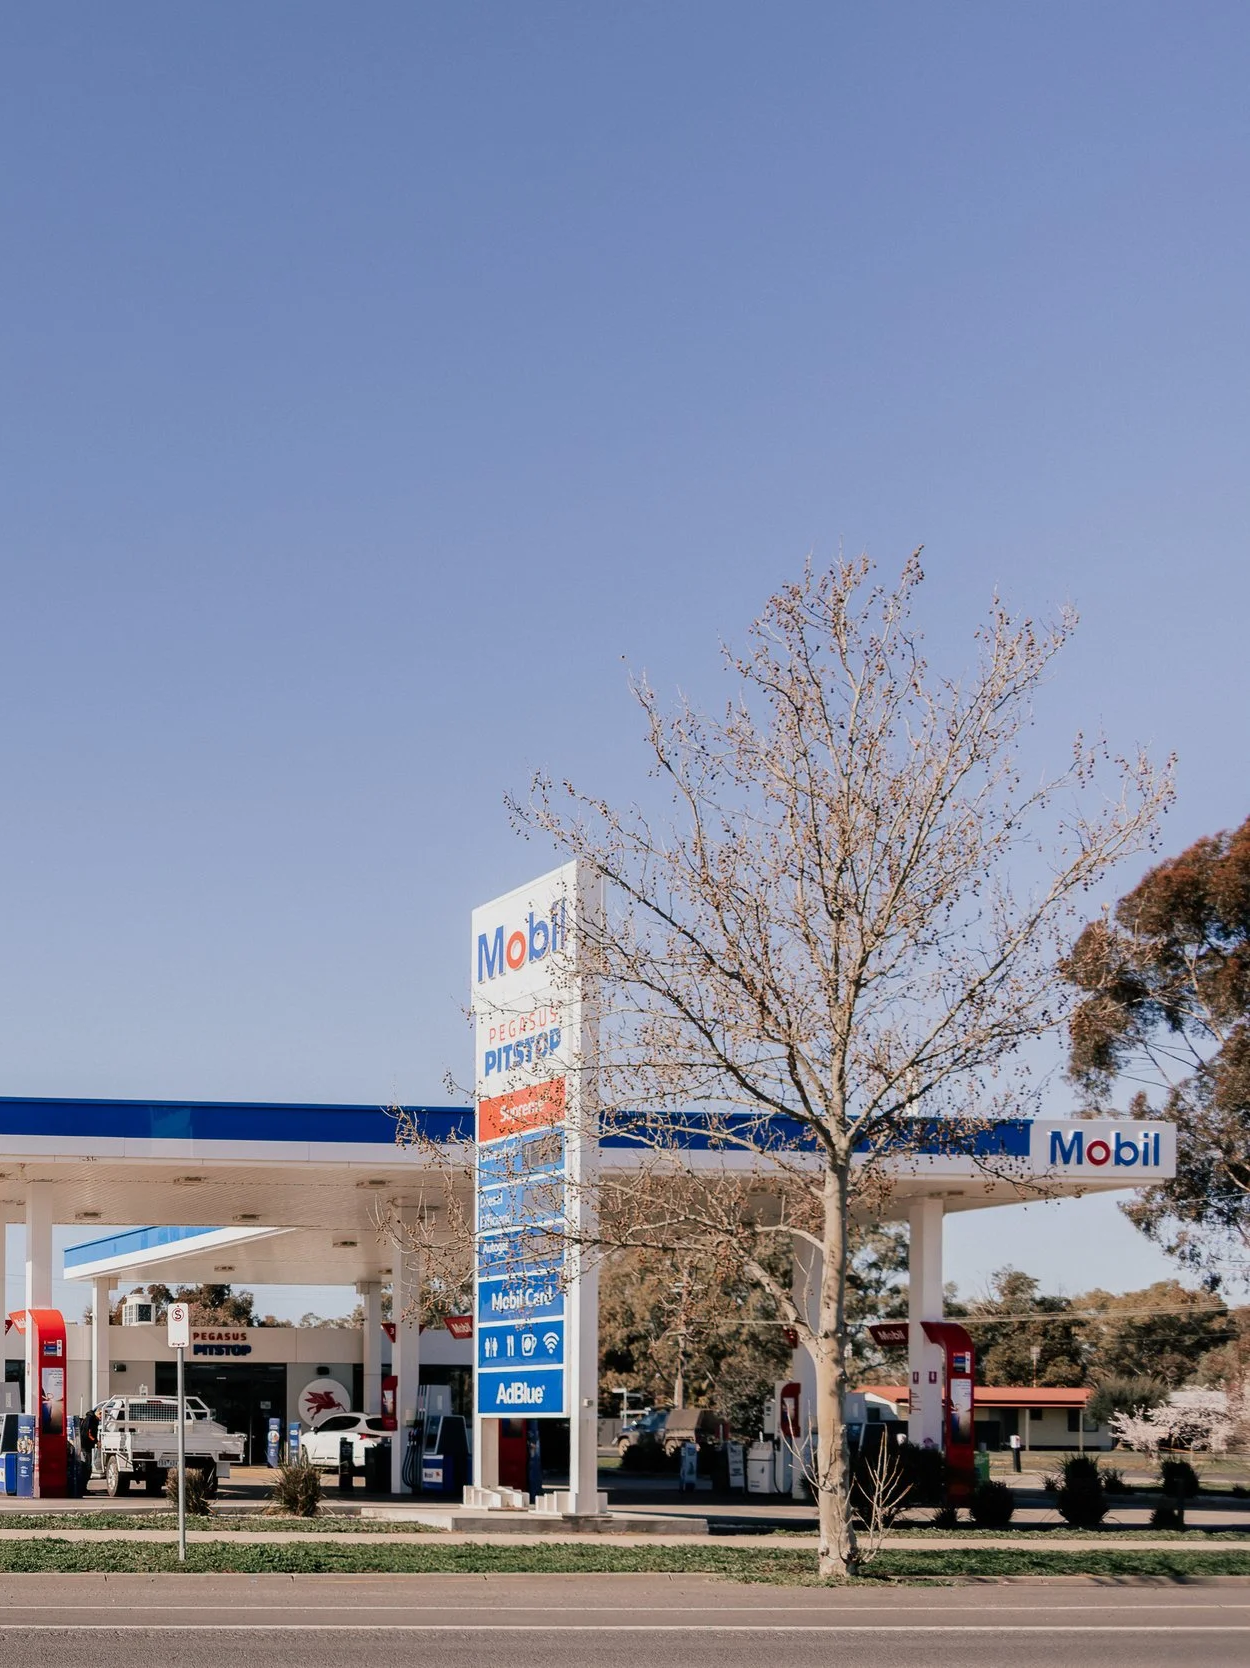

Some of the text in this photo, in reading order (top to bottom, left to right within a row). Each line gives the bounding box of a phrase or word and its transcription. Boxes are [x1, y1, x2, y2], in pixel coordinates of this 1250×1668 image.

[478, 896, 566, 984] Mobil
[489, 1003, 557, 1045] PEGASUS
[484, 1027, 561, 1077] PITSTOP
[1050, 1130, 1160, 1166] Mobil
[492, 1285, 553, 1311] Mobil Card
[193, 1332, 247, 1341] PEGASUS
[879, 1330, 906, 1340] Mobil
[193, 1344, 252, 1356] PITSTOP
[495, 1381, 544, 1405] AdBlue
